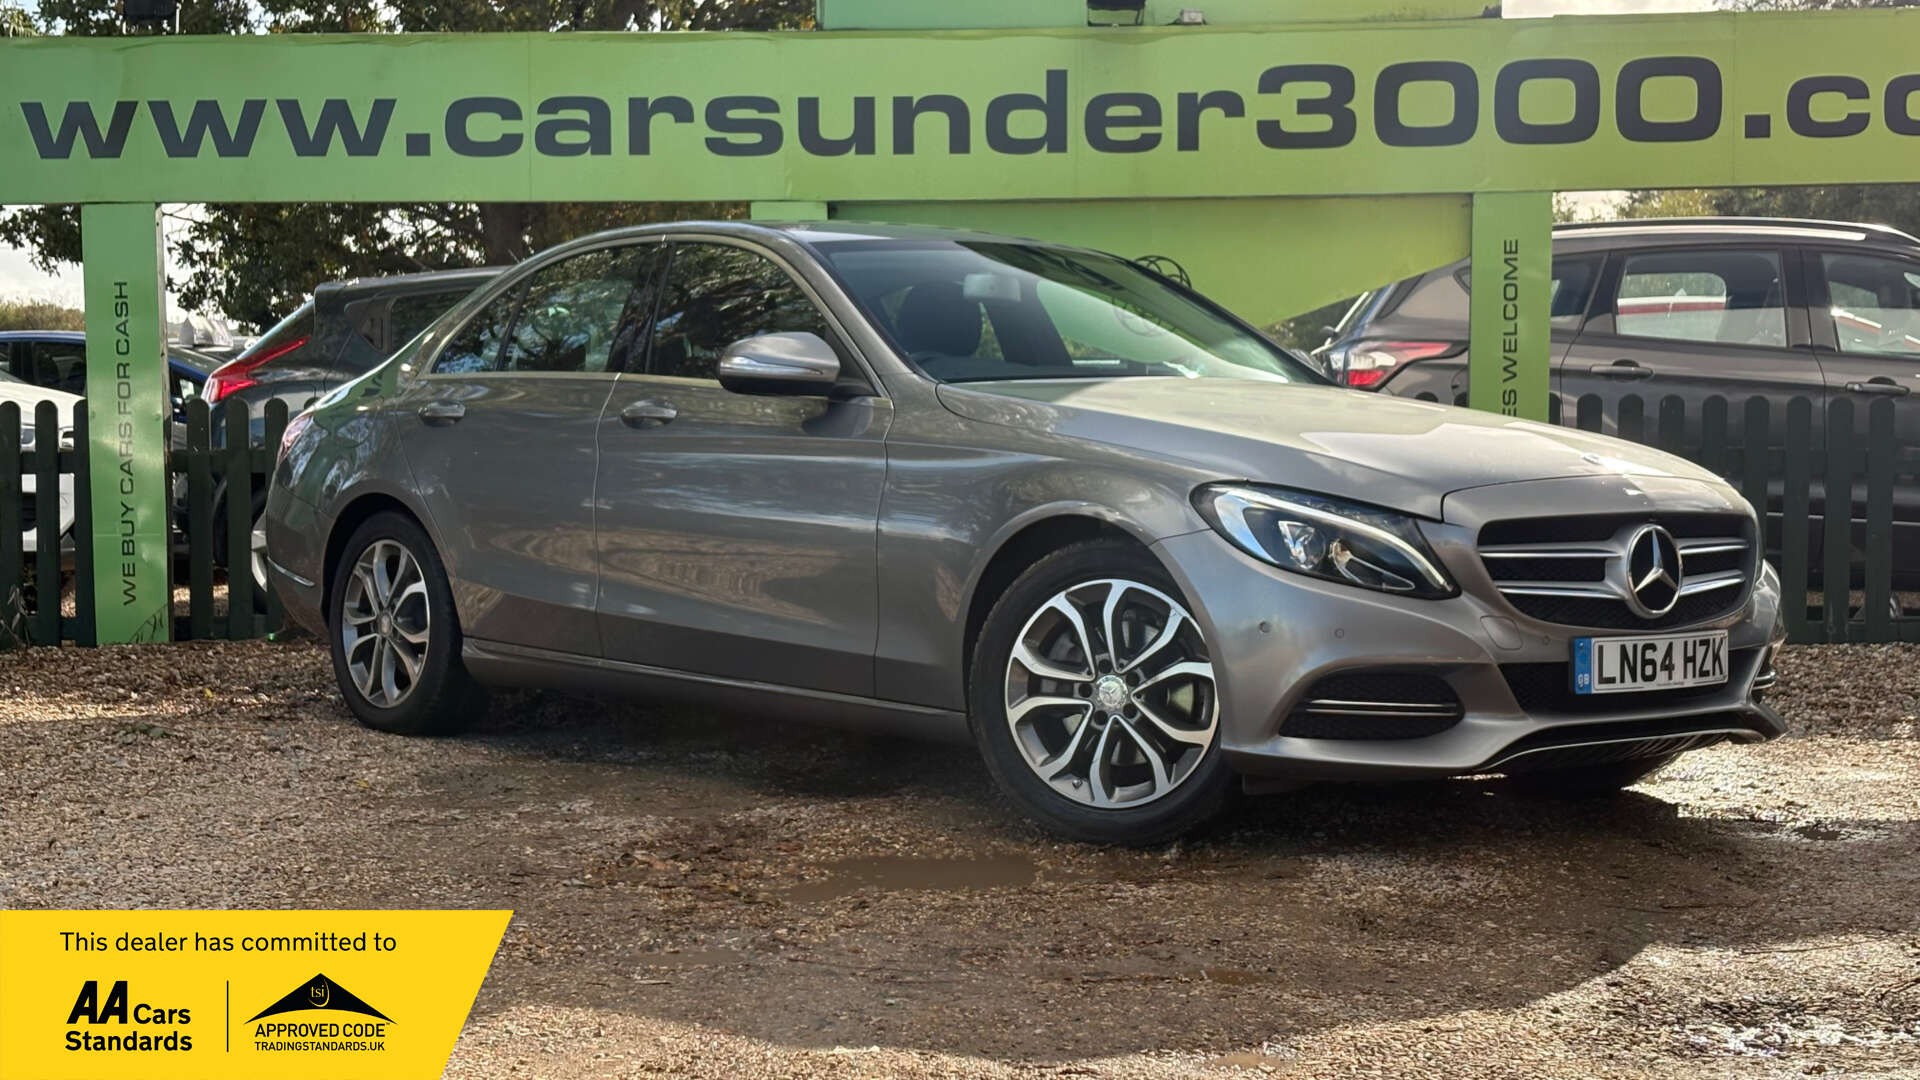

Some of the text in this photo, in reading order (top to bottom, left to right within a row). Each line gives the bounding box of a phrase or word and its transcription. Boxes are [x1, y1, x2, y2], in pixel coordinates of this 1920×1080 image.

[1502, 239, 1519, 383] WELCOME
[114, 281, 137, 607] WE BUY CARS FOR CASH
[1597, 637, 1726, 684] LN64 HZK
